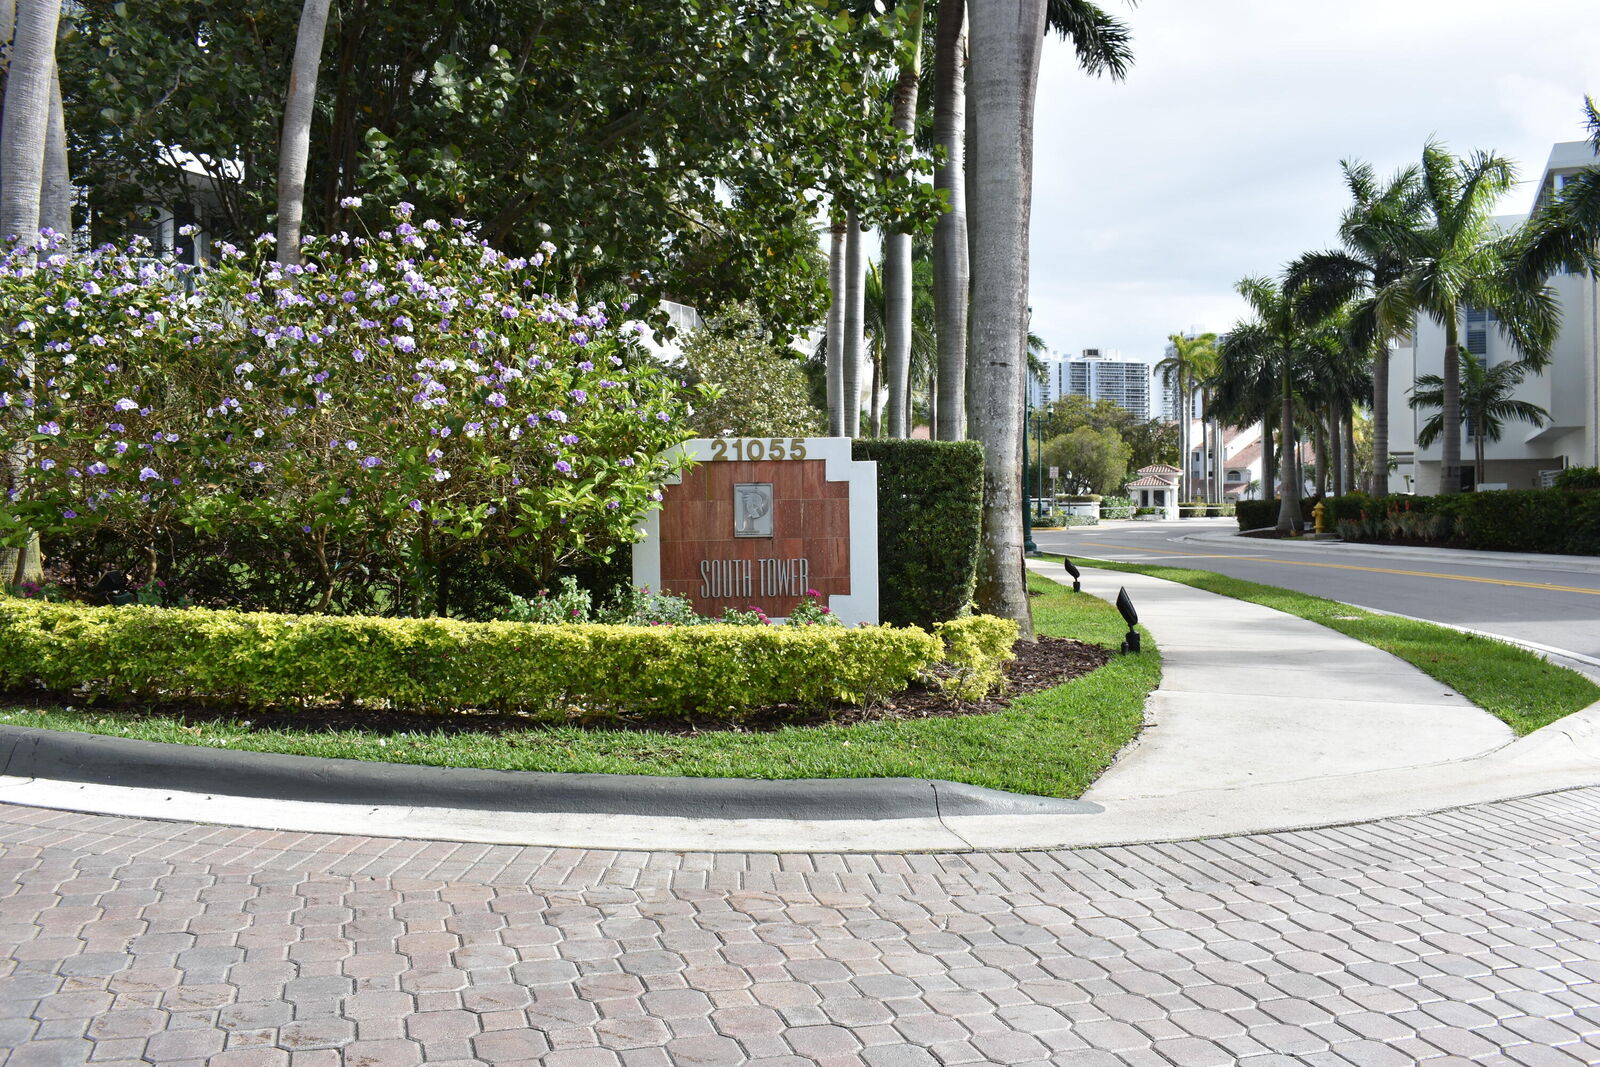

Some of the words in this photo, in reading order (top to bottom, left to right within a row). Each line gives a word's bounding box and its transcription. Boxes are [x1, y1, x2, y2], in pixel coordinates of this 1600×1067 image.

[711, 439, 806, 461] 21055
[700, 559, 752, 598] SOUTH
[758, 558, 809, 597] TOWER
